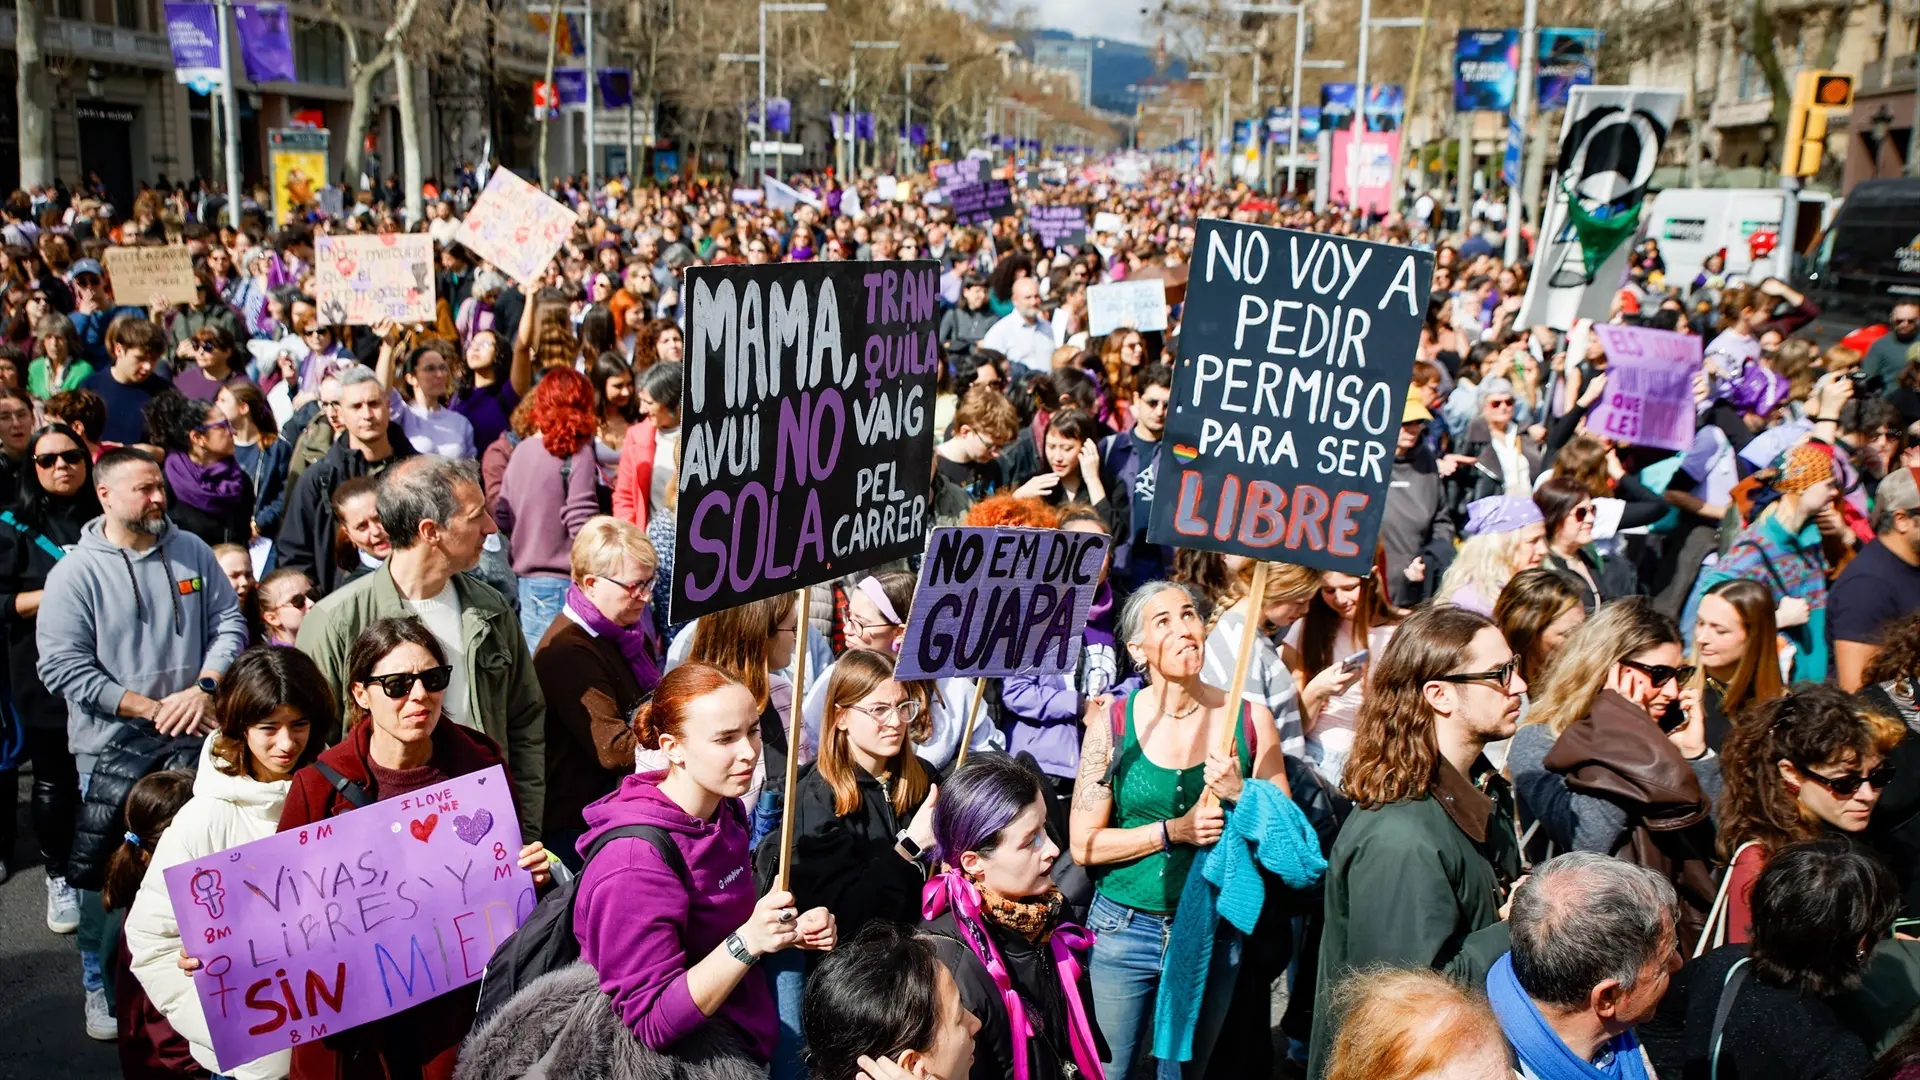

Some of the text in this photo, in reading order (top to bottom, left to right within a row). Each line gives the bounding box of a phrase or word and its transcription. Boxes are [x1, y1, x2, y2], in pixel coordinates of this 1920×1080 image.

[1206, 229, 1419, 316] NO VOY A
[691, 276, 858, 414] MAMA,
[1234, 294, 1372, 368] PEDIR
[1192, 354, 1391, 435] PERMISO
[1612, 392, 1641, 413] QUE
[773, 387, 847, 493] NO
[1198, 418, 1387, 483] PARA SER
[1604, 412, 1638, 437] LES
[684, 460, 906, 602] SOLA PEL
[831, 495, 926, 558] CARRER
[1174, 470, 1369, 556] LIBRE
[928, 529, 984, 587] NO
[987, 534, 1041, 580] EM
[917, 583, 1077, 673] GUAPA
[401, 788, 453, 811] I LOVE
[437, 800, 460, 814] ME
[299, 824, 333, 846] 8 M
[493, 841, 507, 860] 8
[444, 859, 473, 905] Y
[494, 863, 512, 882] M
[204, 926, 233, 944] 8M
[290, 1023, 328, 1044] 8 M
